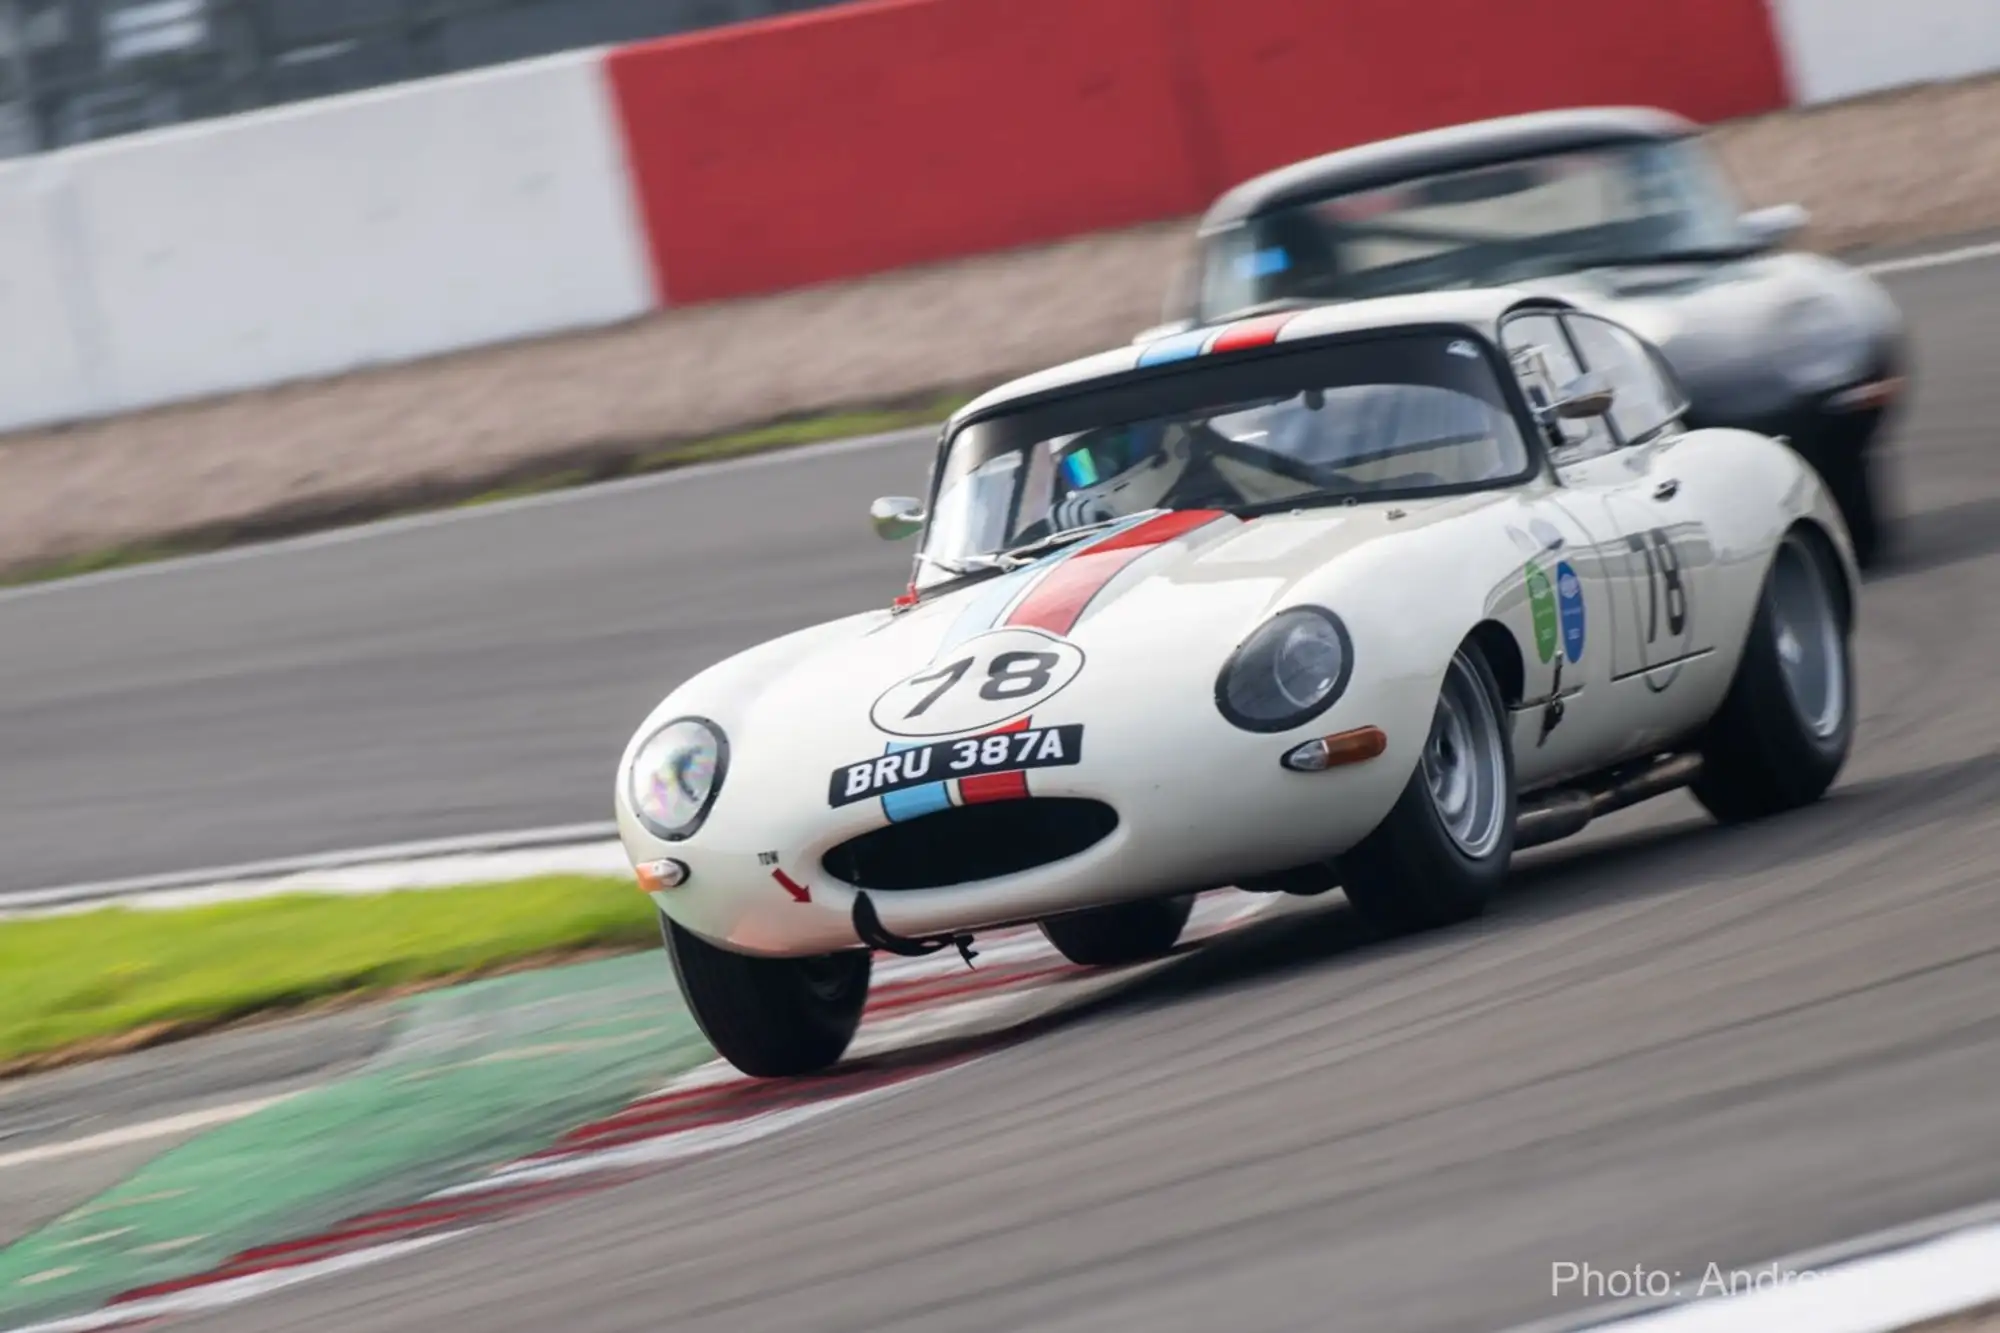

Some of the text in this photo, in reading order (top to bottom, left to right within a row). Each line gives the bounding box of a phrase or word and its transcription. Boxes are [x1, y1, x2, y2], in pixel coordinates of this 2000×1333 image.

[1627, 528, 1688, 643] 78
[903, 651, 1060, 720] 78
[844, 729, 1064, 797] BRU 387A
[757, 850, 779, 866] TOW
